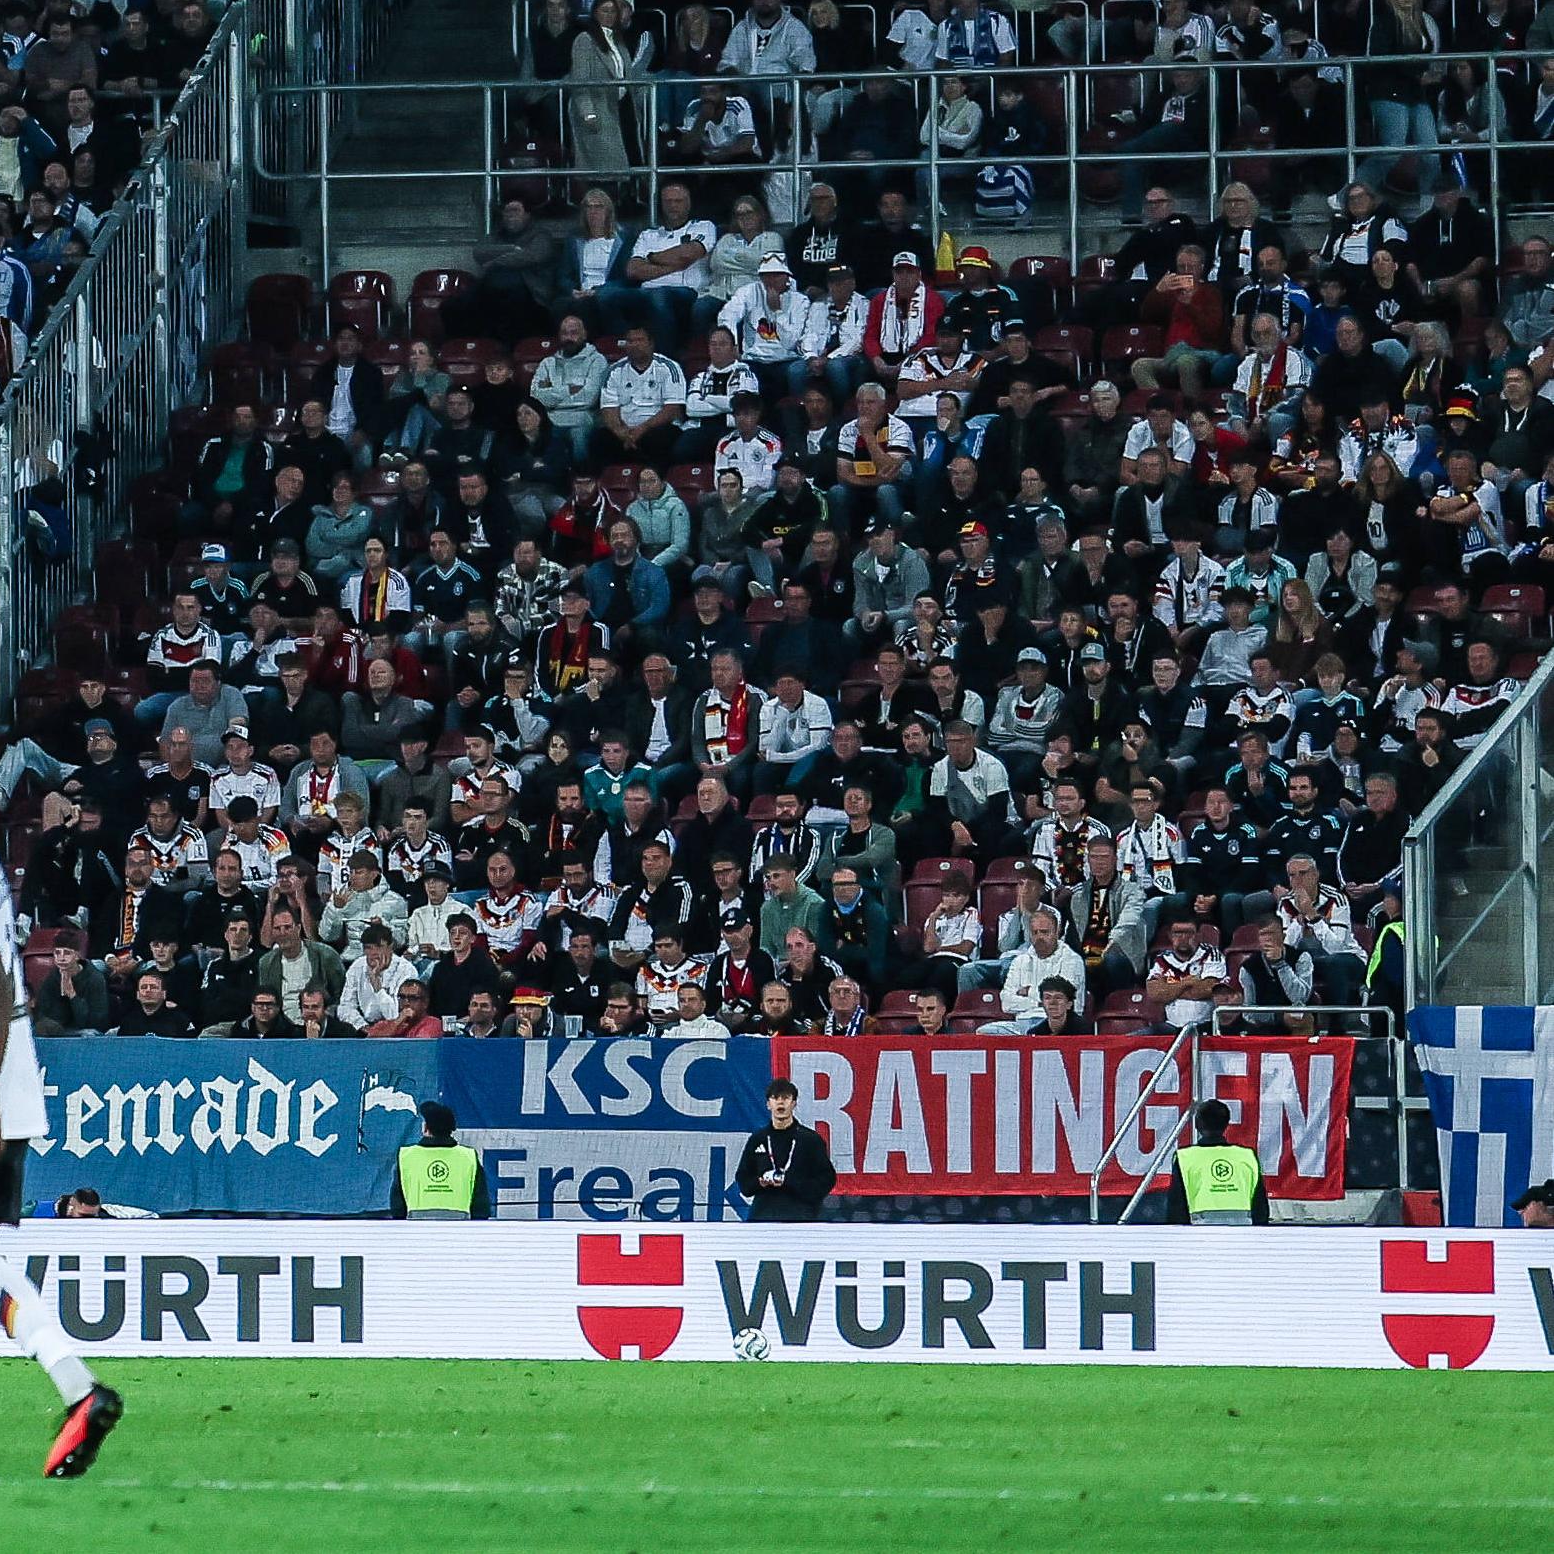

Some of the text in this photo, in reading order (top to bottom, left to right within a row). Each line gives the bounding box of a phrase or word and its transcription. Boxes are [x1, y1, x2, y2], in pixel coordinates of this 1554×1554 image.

[520, 1038, 727, 1118] KSC
[789, 1046, 1336, 1178] RATINGEN
[716, 1260, 1156, 1352] WÜRTH
